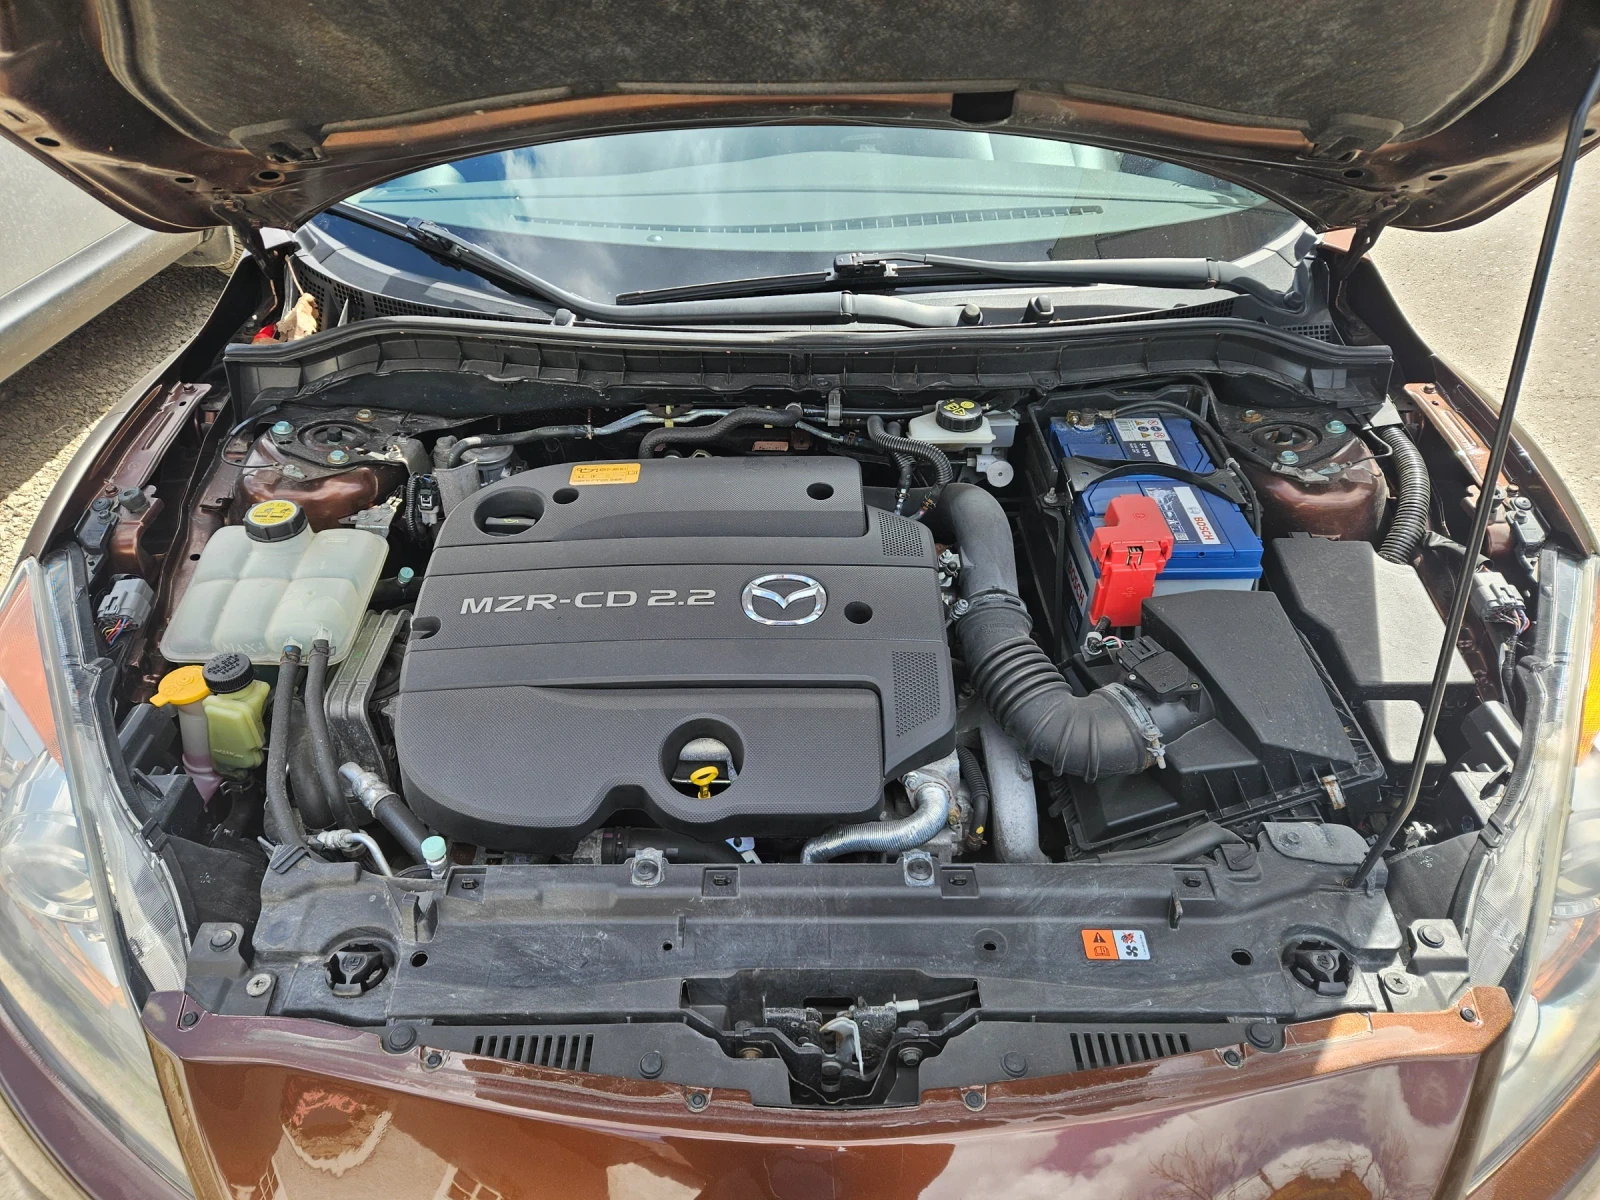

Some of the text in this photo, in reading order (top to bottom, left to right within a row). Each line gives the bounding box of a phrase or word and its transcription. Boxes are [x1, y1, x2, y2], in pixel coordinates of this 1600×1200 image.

[1193, 516, 1215, 541] BOSCH
[1068, 559, 1085, 606] BOSCH
[459, 588, 716, 615] MZR-CD 2.2
